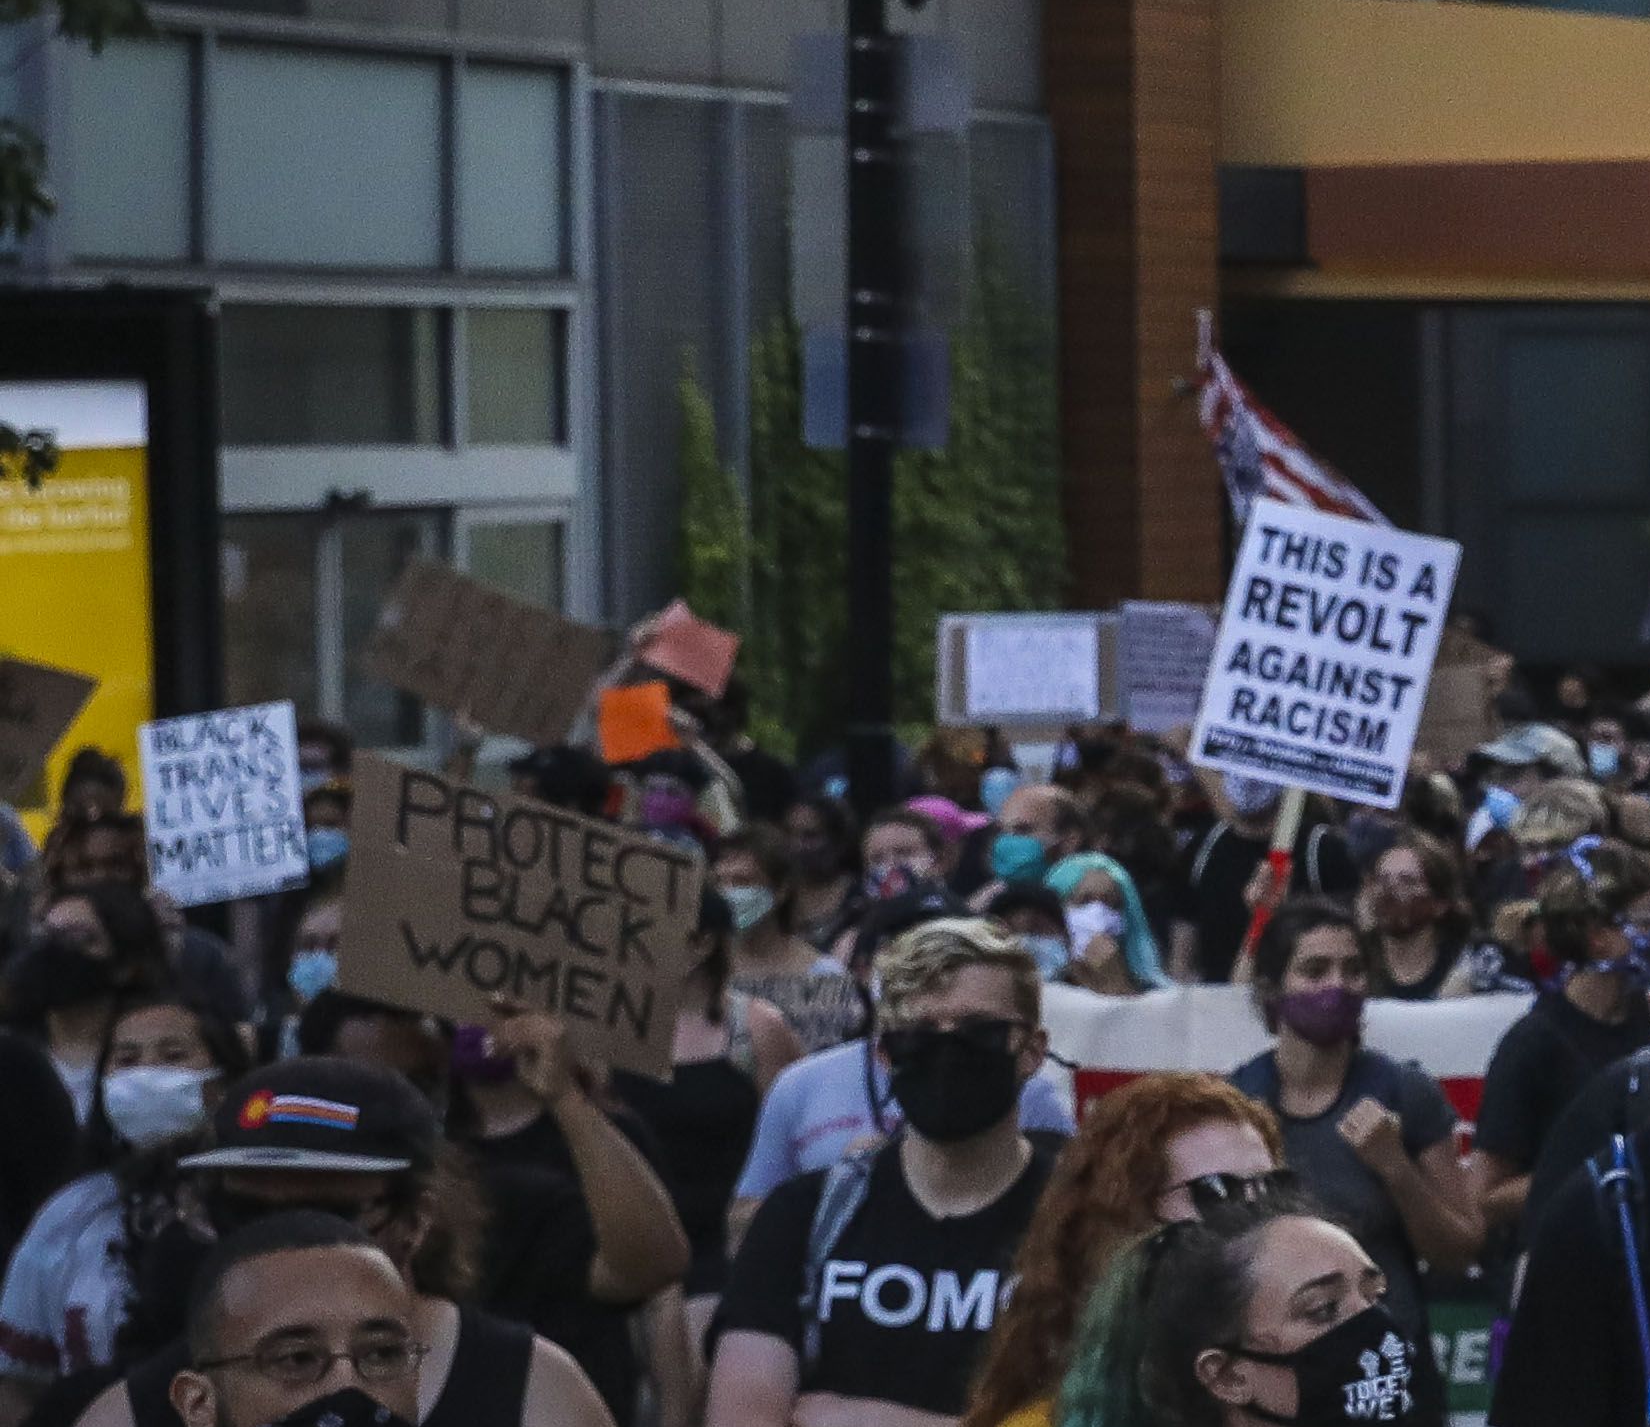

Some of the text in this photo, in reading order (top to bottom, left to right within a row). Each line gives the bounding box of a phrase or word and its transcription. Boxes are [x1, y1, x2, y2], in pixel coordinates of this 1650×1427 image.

[1258, 525, 1437, 603] THIS IS A
[1240, 575, 1429, 658] REVOLT
[1225, 638, 1415, 712] AGAINST
[1228, 686, 1390, 756] RACISM
[154, 775, 292, 830] LIVES
[157, 749, 288, 796] TRANS
[151, 819, 303, 876] MATTER
[398, 770, 696, 913] PROTECT
[461, 856, 655, 965] BLACK
[400, 918, 655, 1039] WOMEN
[816, 1259, 1024, 1333] FOM
